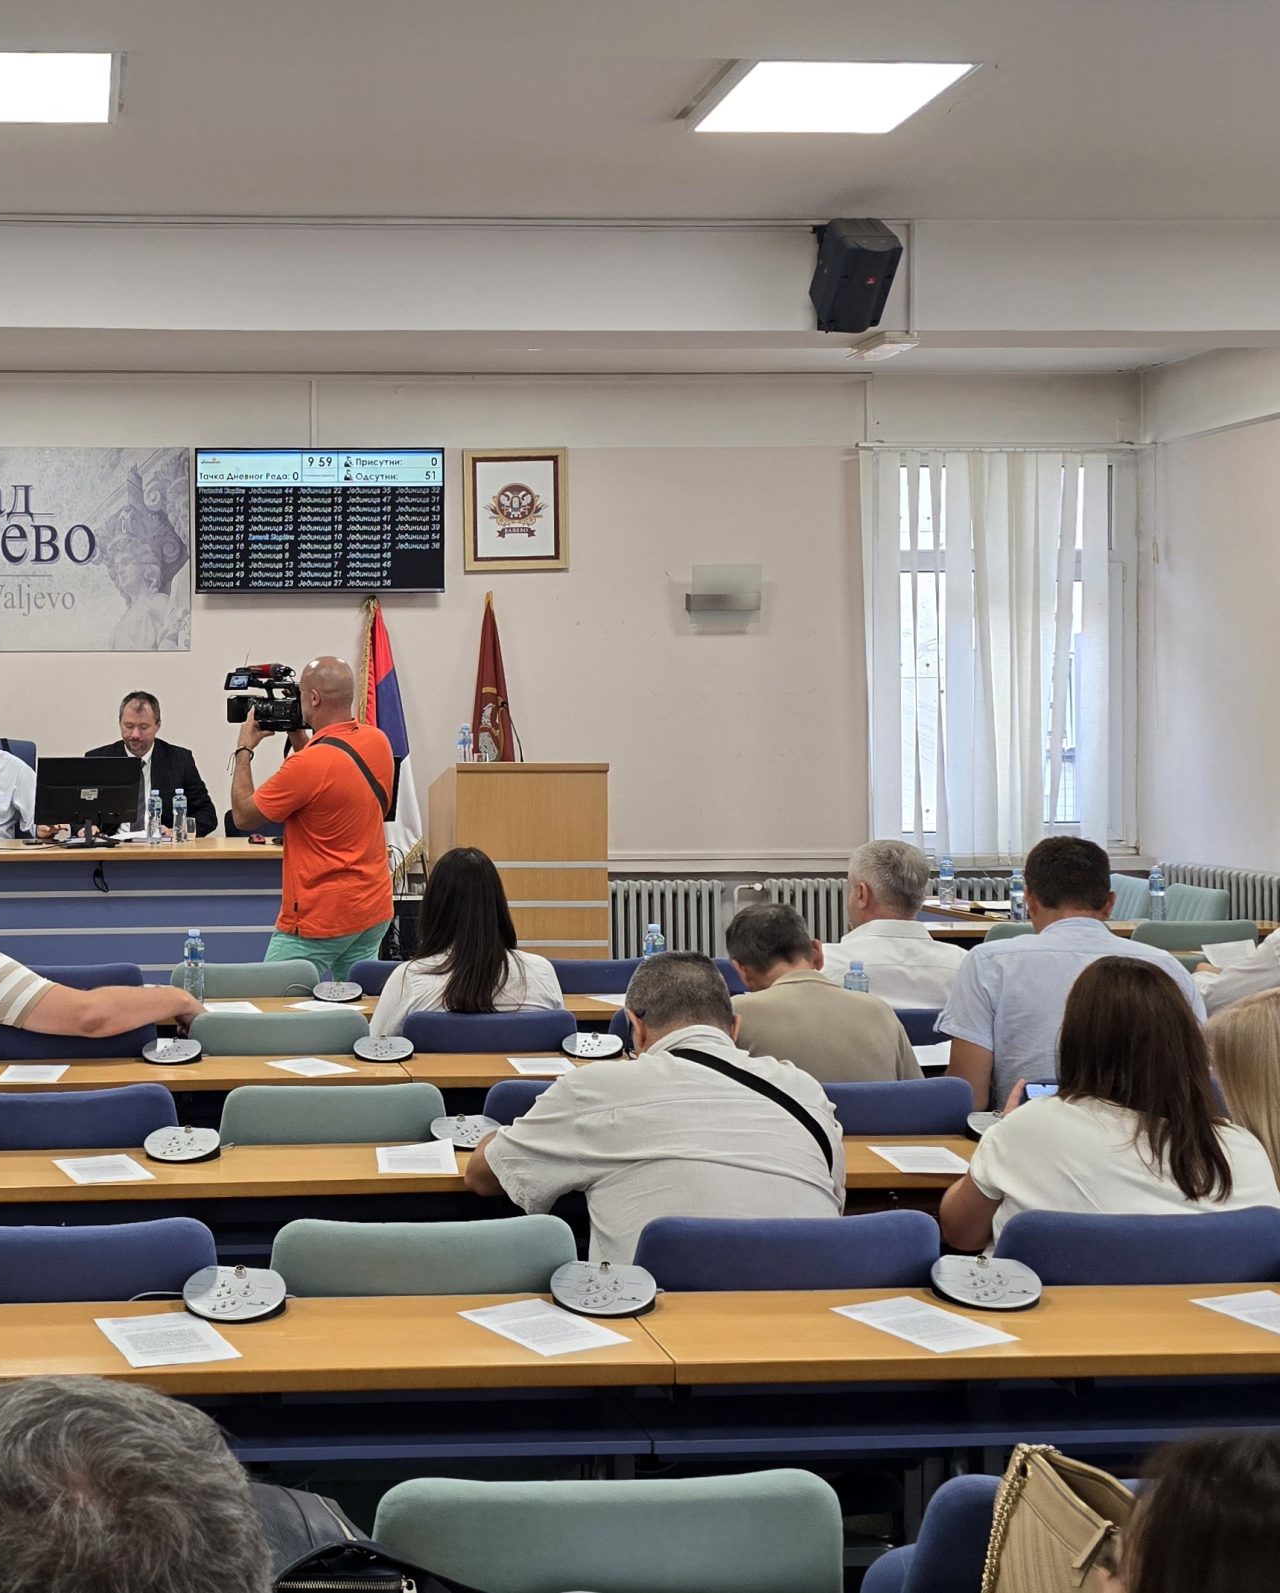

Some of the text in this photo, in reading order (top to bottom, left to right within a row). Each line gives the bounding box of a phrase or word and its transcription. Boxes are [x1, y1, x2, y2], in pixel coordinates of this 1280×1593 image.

[308, 457, 332, 467] 9 59
[355, 457, 438, 467] Присутни: 0
[226, 472, 263, 480] Дневног
[266, 472, 290, 480] Реда:
[292, 472, 299, 480] 0
[355, 471, 437, 482] Одсутни: 51
